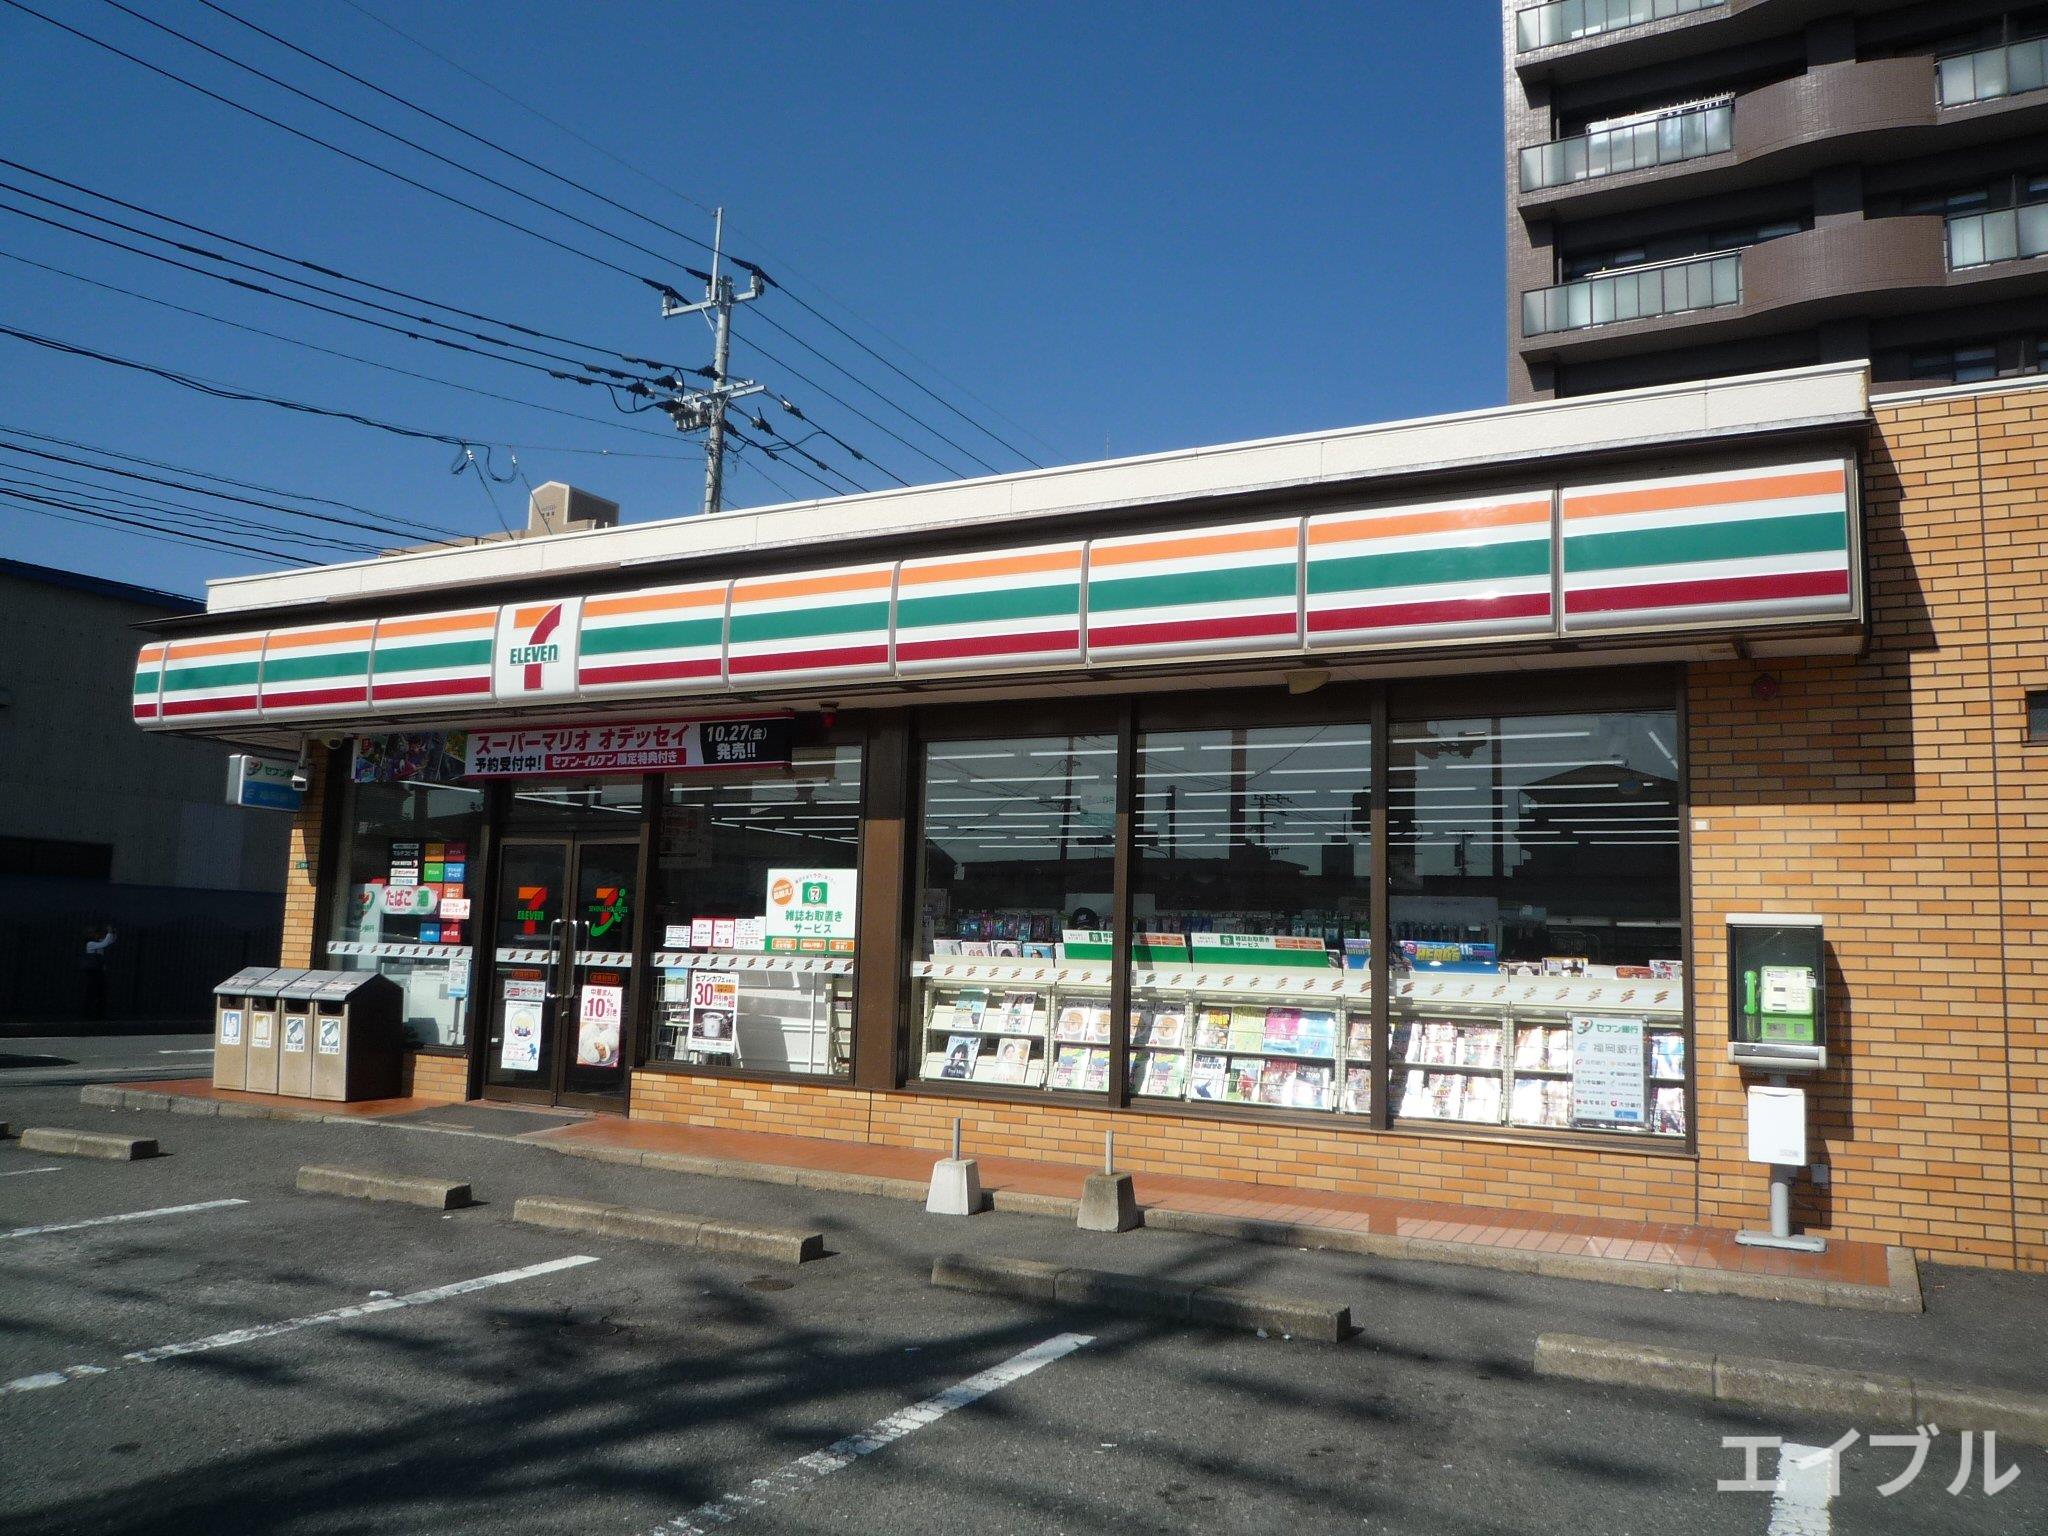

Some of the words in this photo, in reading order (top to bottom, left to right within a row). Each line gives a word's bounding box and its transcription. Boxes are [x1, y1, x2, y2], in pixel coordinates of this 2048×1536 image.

[475, 731, 591, 755] スーパーマリオ
[598, 724, 690, 749] オデッセイ
[717, 742, 756, 760] 発売!!
[475, 756, 542, 773] 予約受付中!
[385, 889, 412, 906] たばこ
[785, 910, 843, 923] 雑誌お取置き
[794, 924, 832, 934] サービス
[694, 983, 713, 1006] 30
[587, 998, 605, 1017] 10
